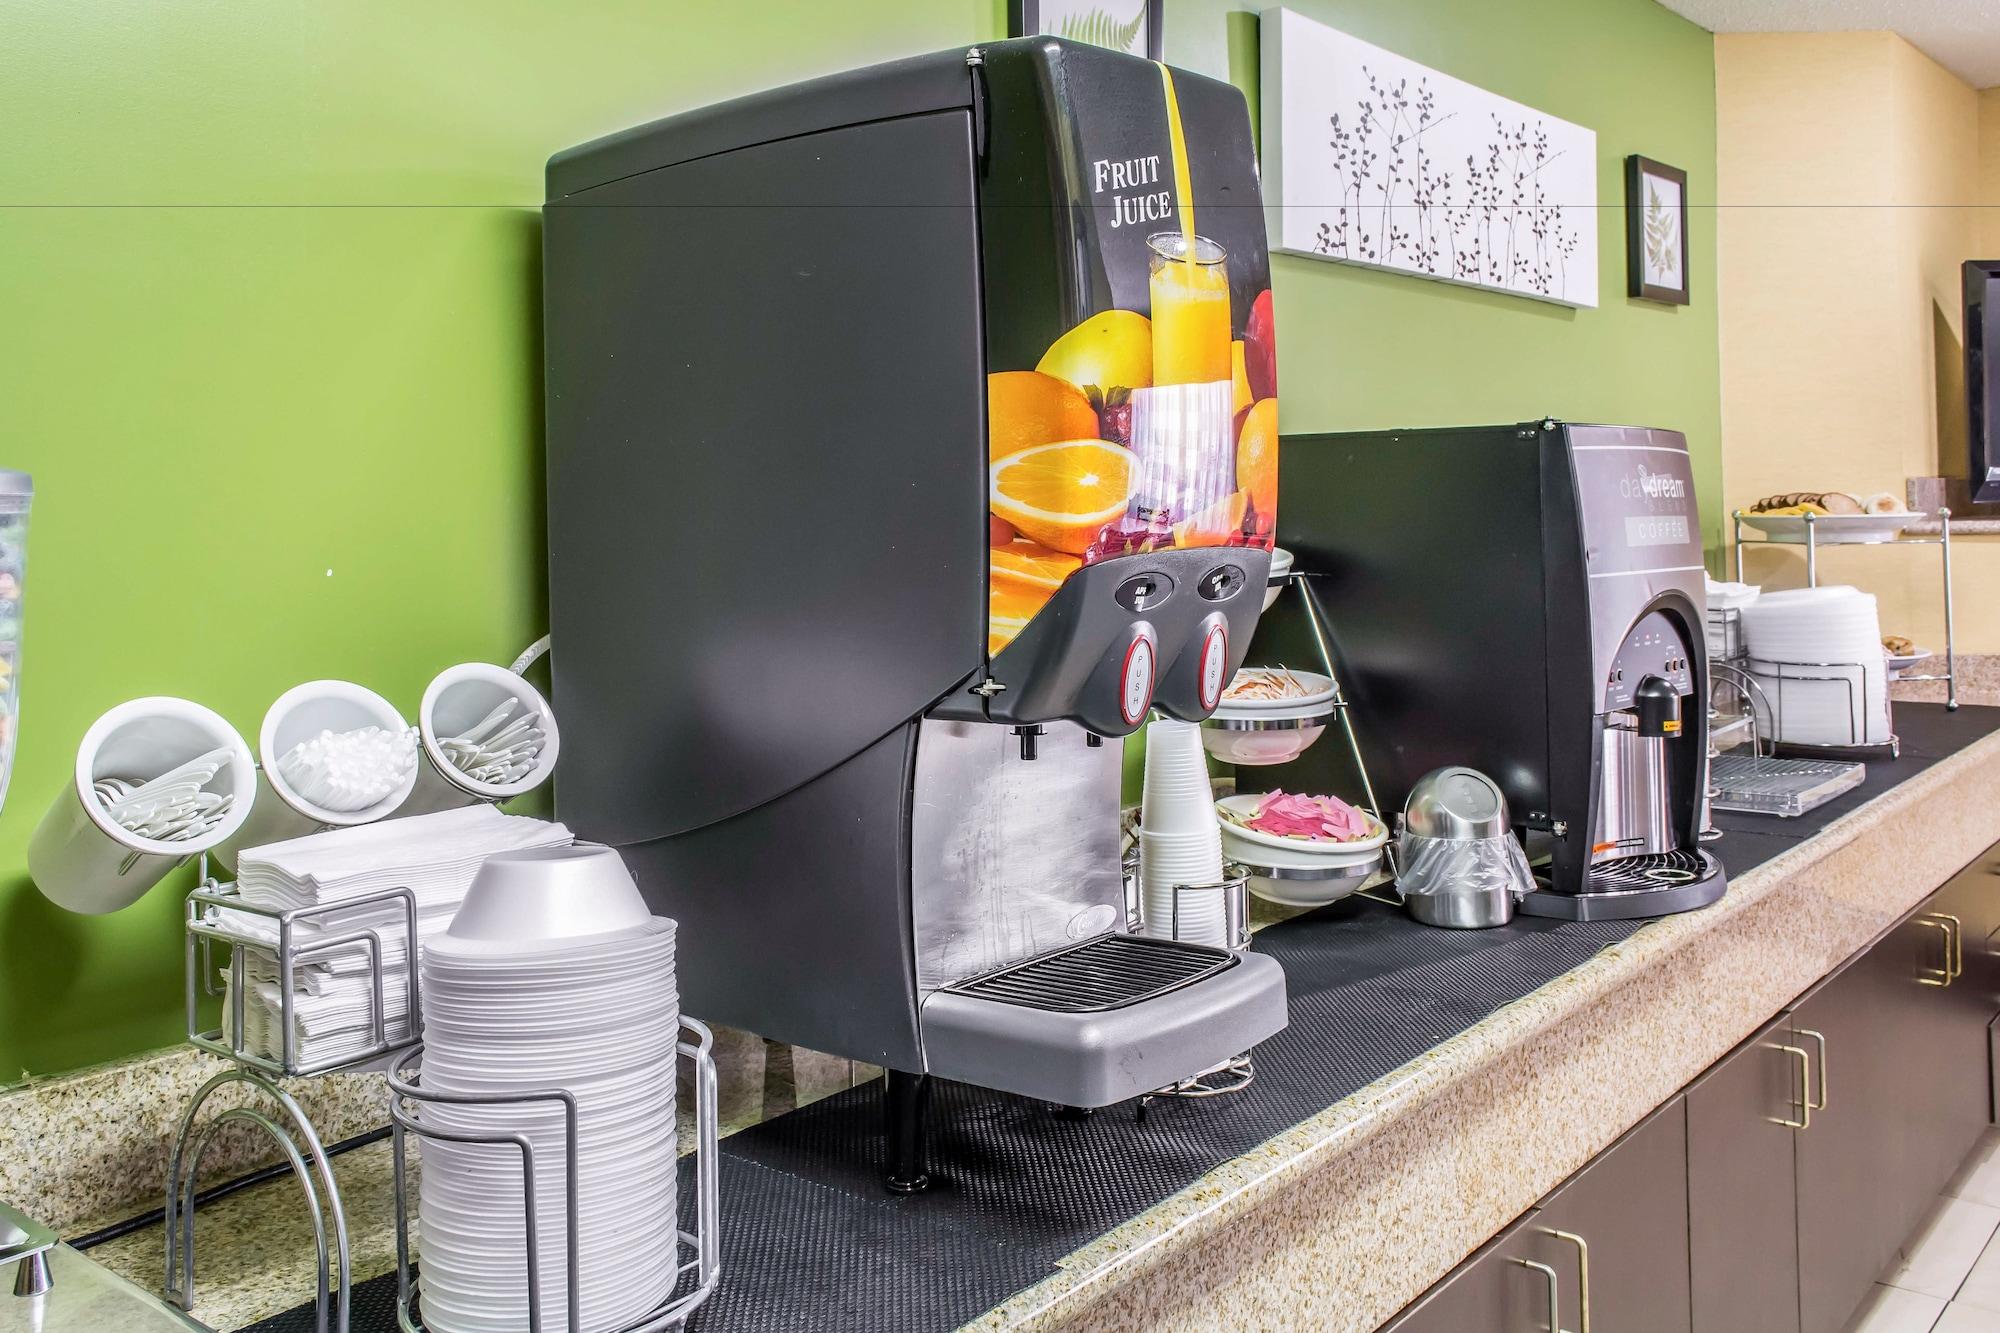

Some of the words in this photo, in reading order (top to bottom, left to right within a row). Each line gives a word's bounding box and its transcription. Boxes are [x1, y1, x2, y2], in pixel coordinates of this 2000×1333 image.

[1093, 155, 1160, 193] FRUIT
[1110, 191, 1172, 228] JUICE
[1620, 471, 1685, 504] daydream
[1639, 522, 1684, 538] COFFEE
[1133, 655, 1143, 705] PUSH
[1210, 644, 1218, 691] PUSH
